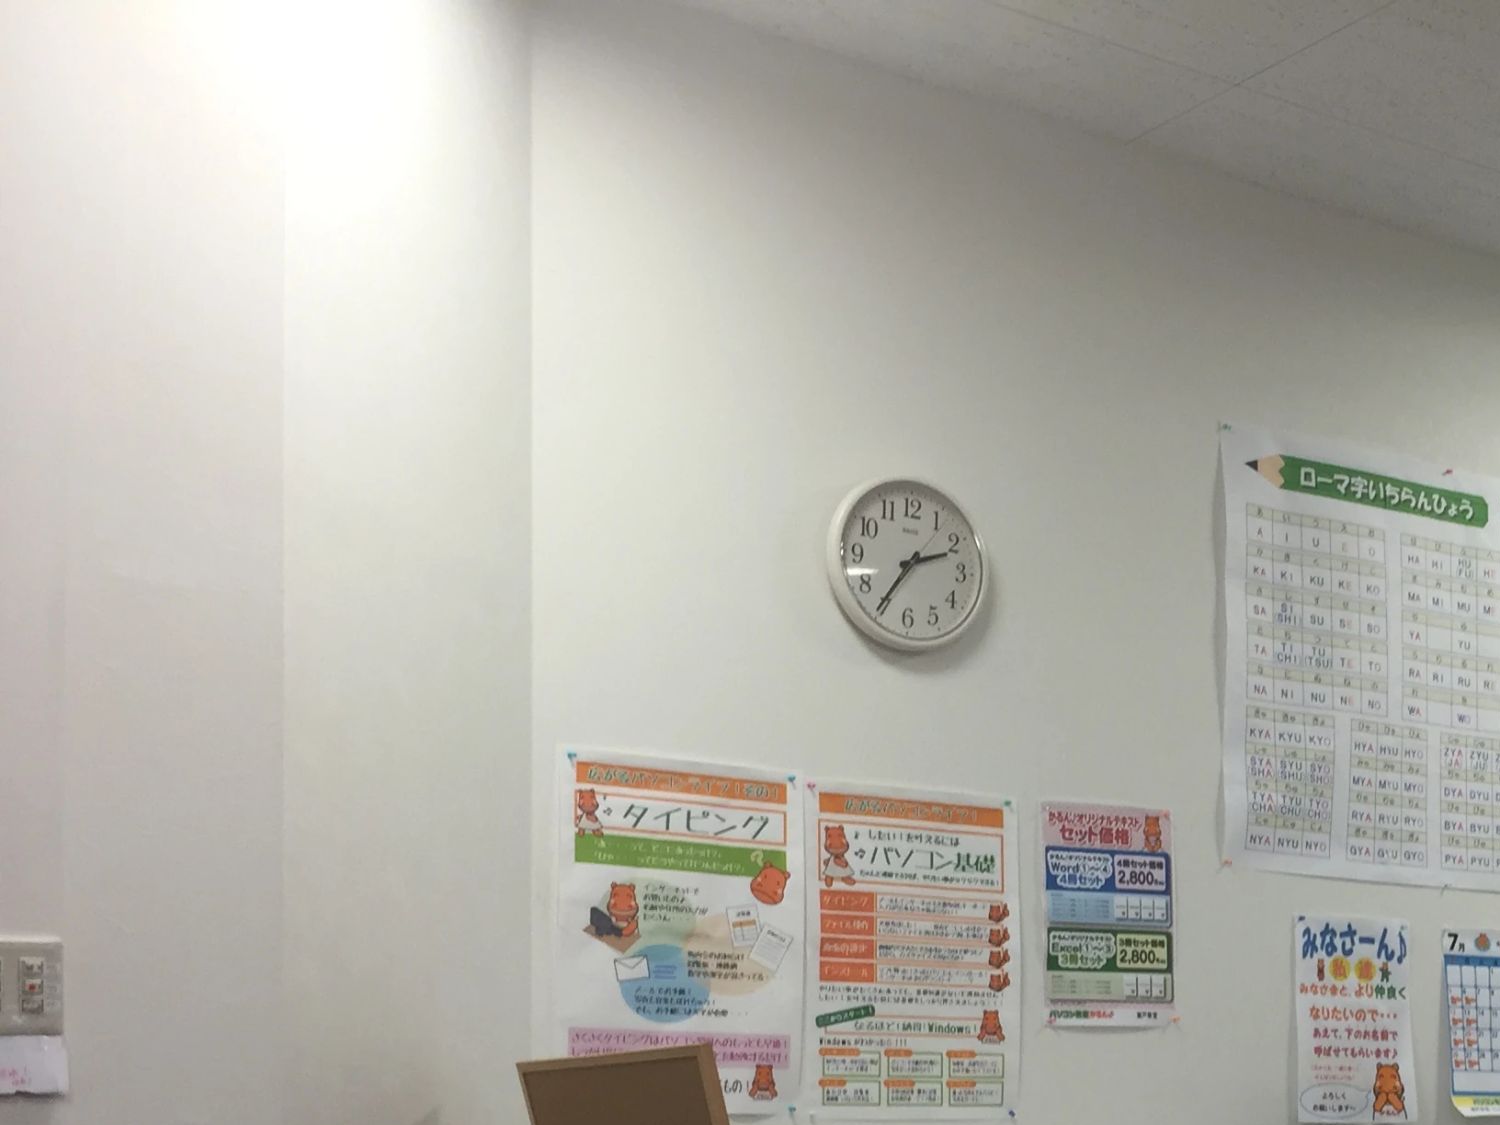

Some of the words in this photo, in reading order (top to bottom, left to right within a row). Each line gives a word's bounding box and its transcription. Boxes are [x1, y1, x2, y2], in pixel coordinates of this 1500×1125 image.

[1299, 466, 1474, 520] ローマ字いちらんひょう
[881, 500, 894, 521] 11
[904, 498, 922, 519] 12
[860, 516, 878, 539] 10
[934, 511, 939, 531] 1
[948, 533, 959, 553] 2
[852, 543, 864, 564] 9
[955, 563, 966, 583] 3
[859, 574, 871, 593] 8
[945, 590, 956, 609] 4
[902, 608, 914, 628] 6
[928, 605, 938, 626] 5
[1250, 728, 1271, 739] KYA
[1278, 730, 1301, 743] KYU
[1309, 734, 1331, 746] KYO
[623, 803, 769, 840] タイピング
[1060, 825, 1129, 845] セット価格
[1250, 835, 1270, 846] NYA
[1277, 837, 1298, 849] NYU
[1305, 840, 1326, 852] NYO
[870, 846, 996, 874] パソコン基礎
[1302, 922, 1395, 961] みなさーん
[1447, 933, 1466, 952] 7月
